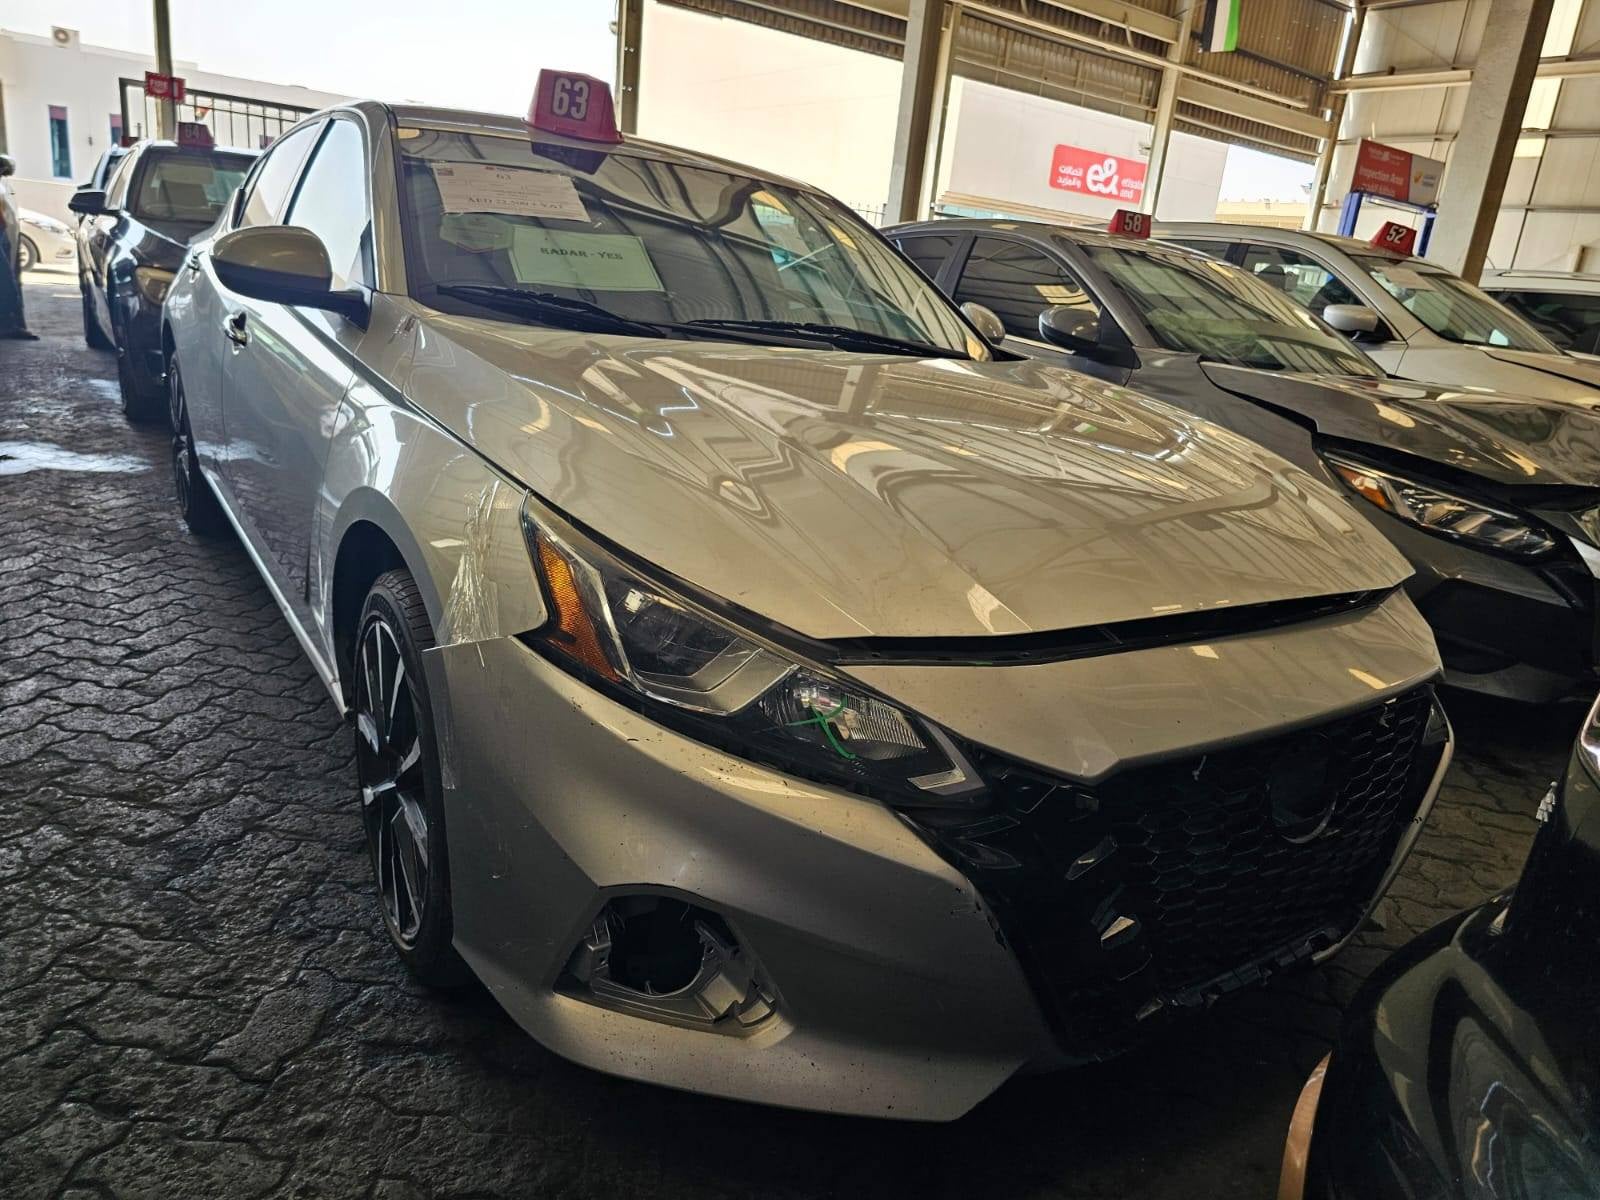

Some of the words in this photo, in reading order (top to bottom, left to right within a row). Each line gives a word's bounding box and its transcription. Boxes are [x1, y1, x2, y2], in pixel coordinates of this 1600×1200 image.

[551, 77, 589, 120] 63
[1086, 157, 1119, 195] e&
[1124, 212, 1142, 233] 58
[1386, 224, 1407, 245] 52
[539, 247, 589, 258] RADAR
[597, 251, 624, 260] YES
